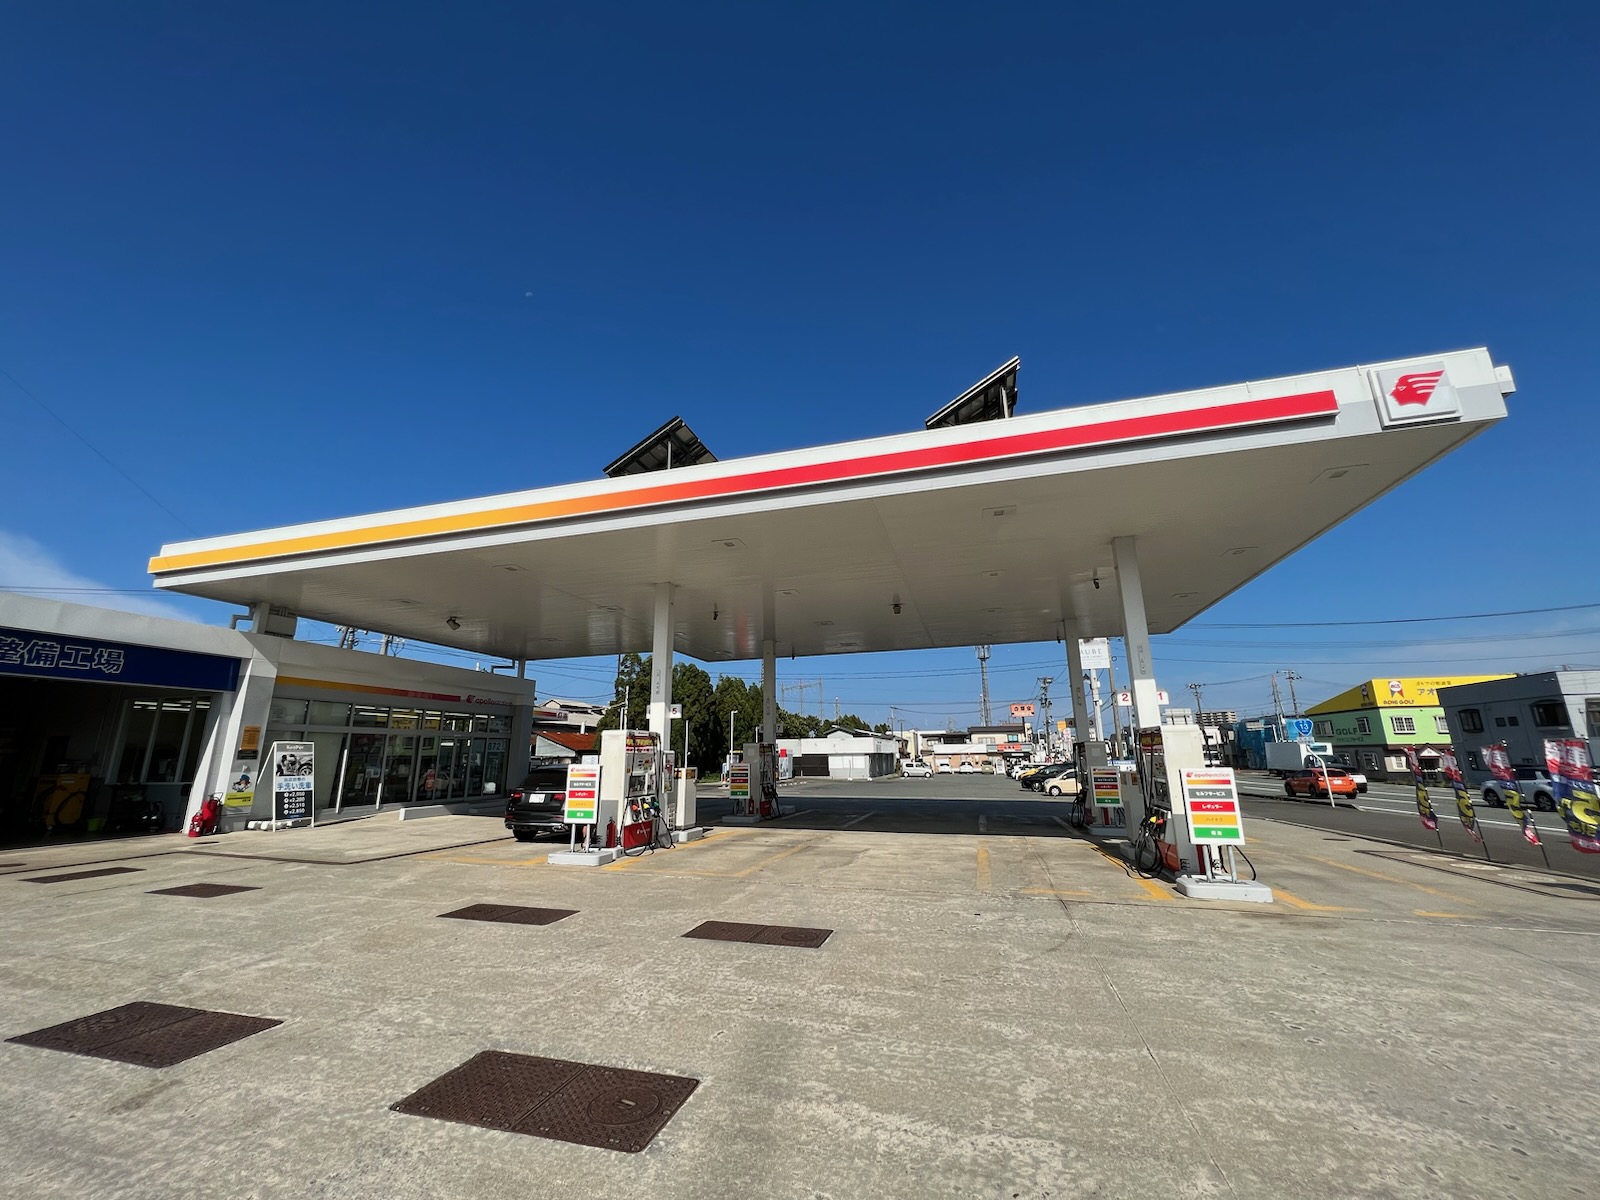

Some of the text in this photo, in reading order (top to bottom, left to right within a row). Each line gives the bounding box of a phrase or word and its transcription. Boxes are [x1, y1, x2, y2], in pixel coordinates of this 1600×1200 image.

[0, 636, 124, 673] 整備工場
[1121, 693, 1129, 702] 2
[1158, 692, 1163, 701] 1
[672, 707, 678, 715] 5
[1335, 727, 1358, 736] GOLF
